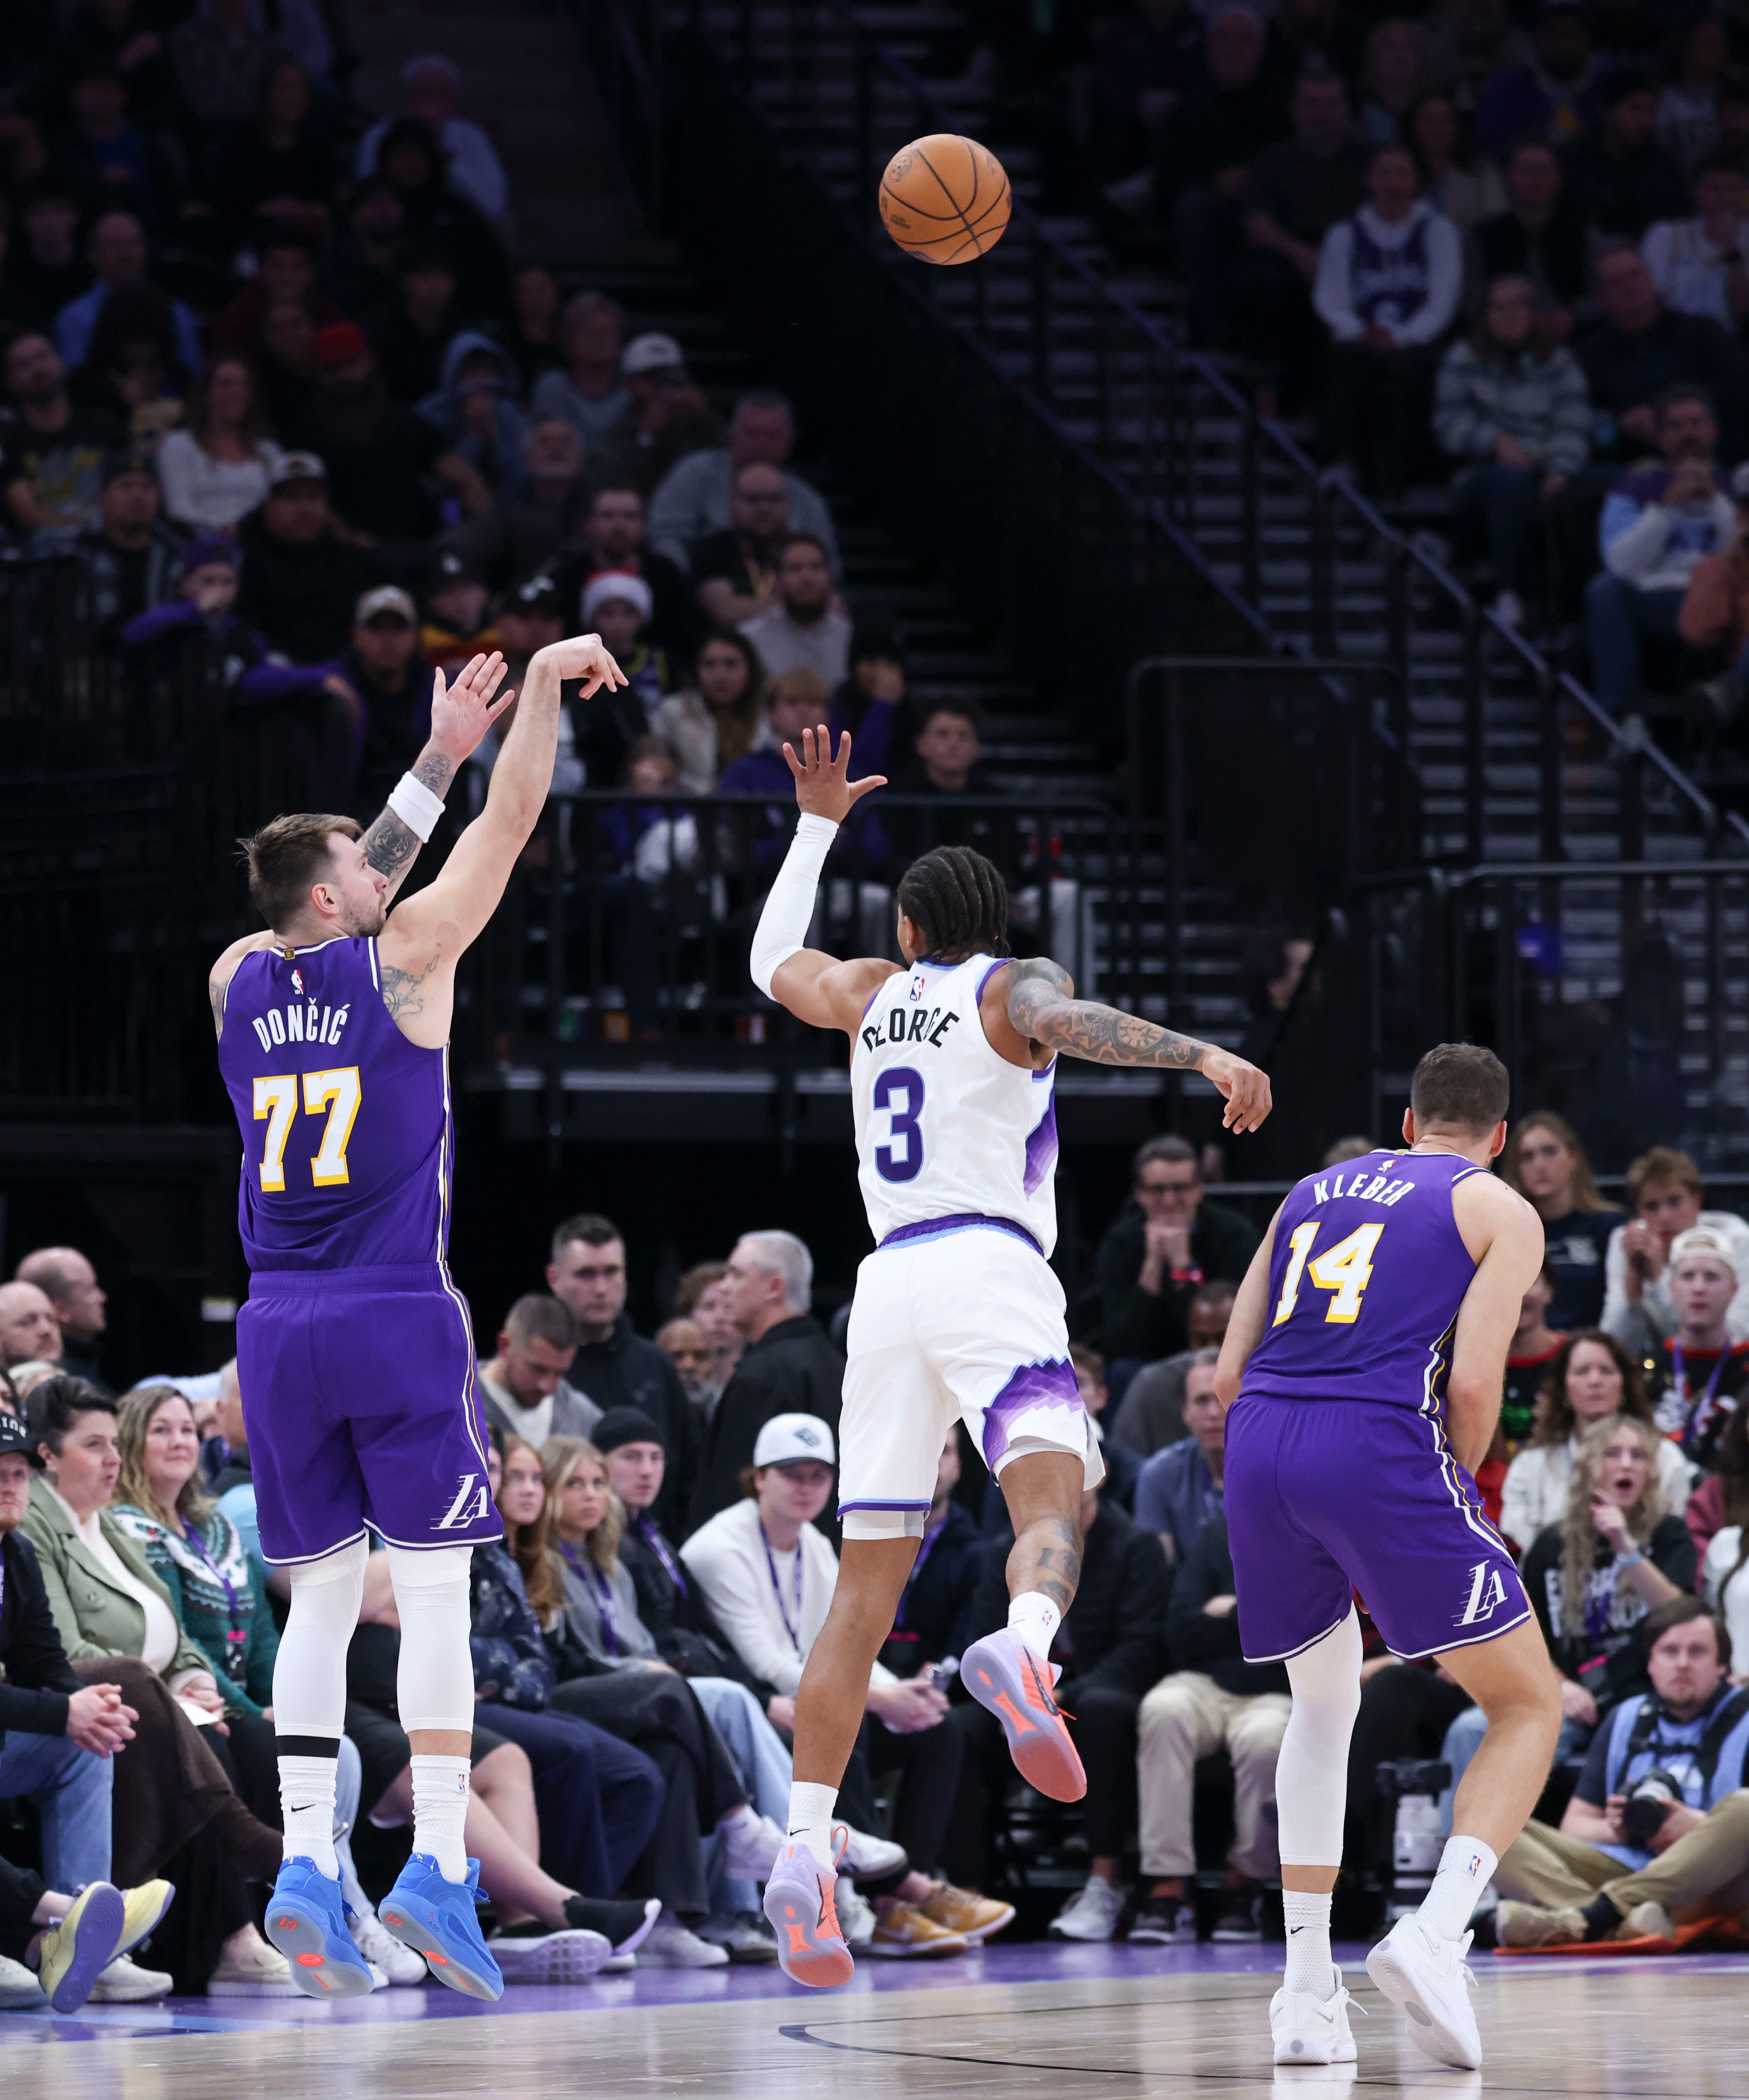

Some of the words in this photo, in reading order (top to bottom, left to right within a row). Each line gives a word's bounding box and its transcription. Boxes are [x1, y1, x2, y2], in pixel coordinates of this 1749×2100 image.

[252, 997, 351, 1053] DONČIĆ
[252, 1066, 362, 1192] 77
[873, 1066, 925, 1184] 3
[1313, 1173, 1416, 1207] KLEBER
[1272, 1222, 1385, 1328] 14
[430, 1473, 490, 1529] LA
[1451, 1559, 1508, 1627] LA
